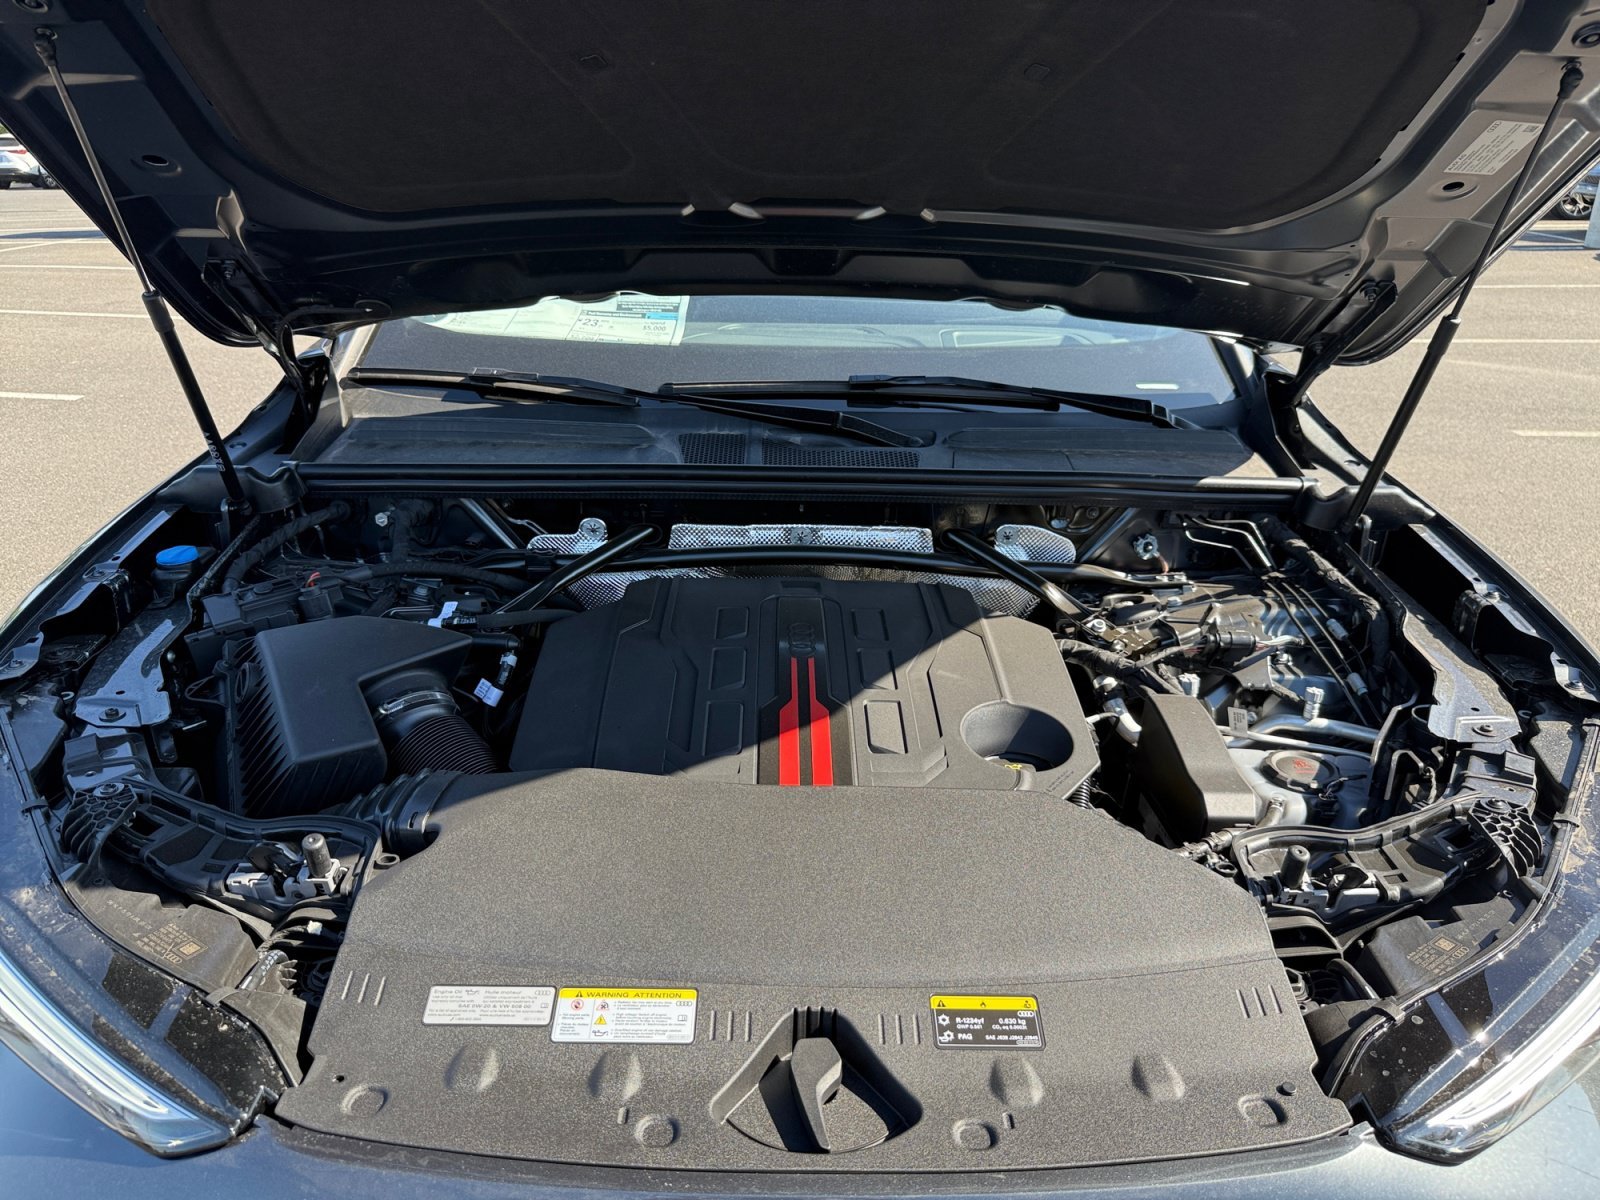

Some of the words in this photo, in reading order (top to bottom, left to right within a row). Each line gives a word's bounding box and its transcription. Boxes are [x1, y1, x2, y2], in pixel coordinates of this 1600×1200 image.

[955, 1016, 985, 1025] R-1234yf
[1017, 1017, 1027, 1026] kg
[957, 1032, 973, 1041] PAG
